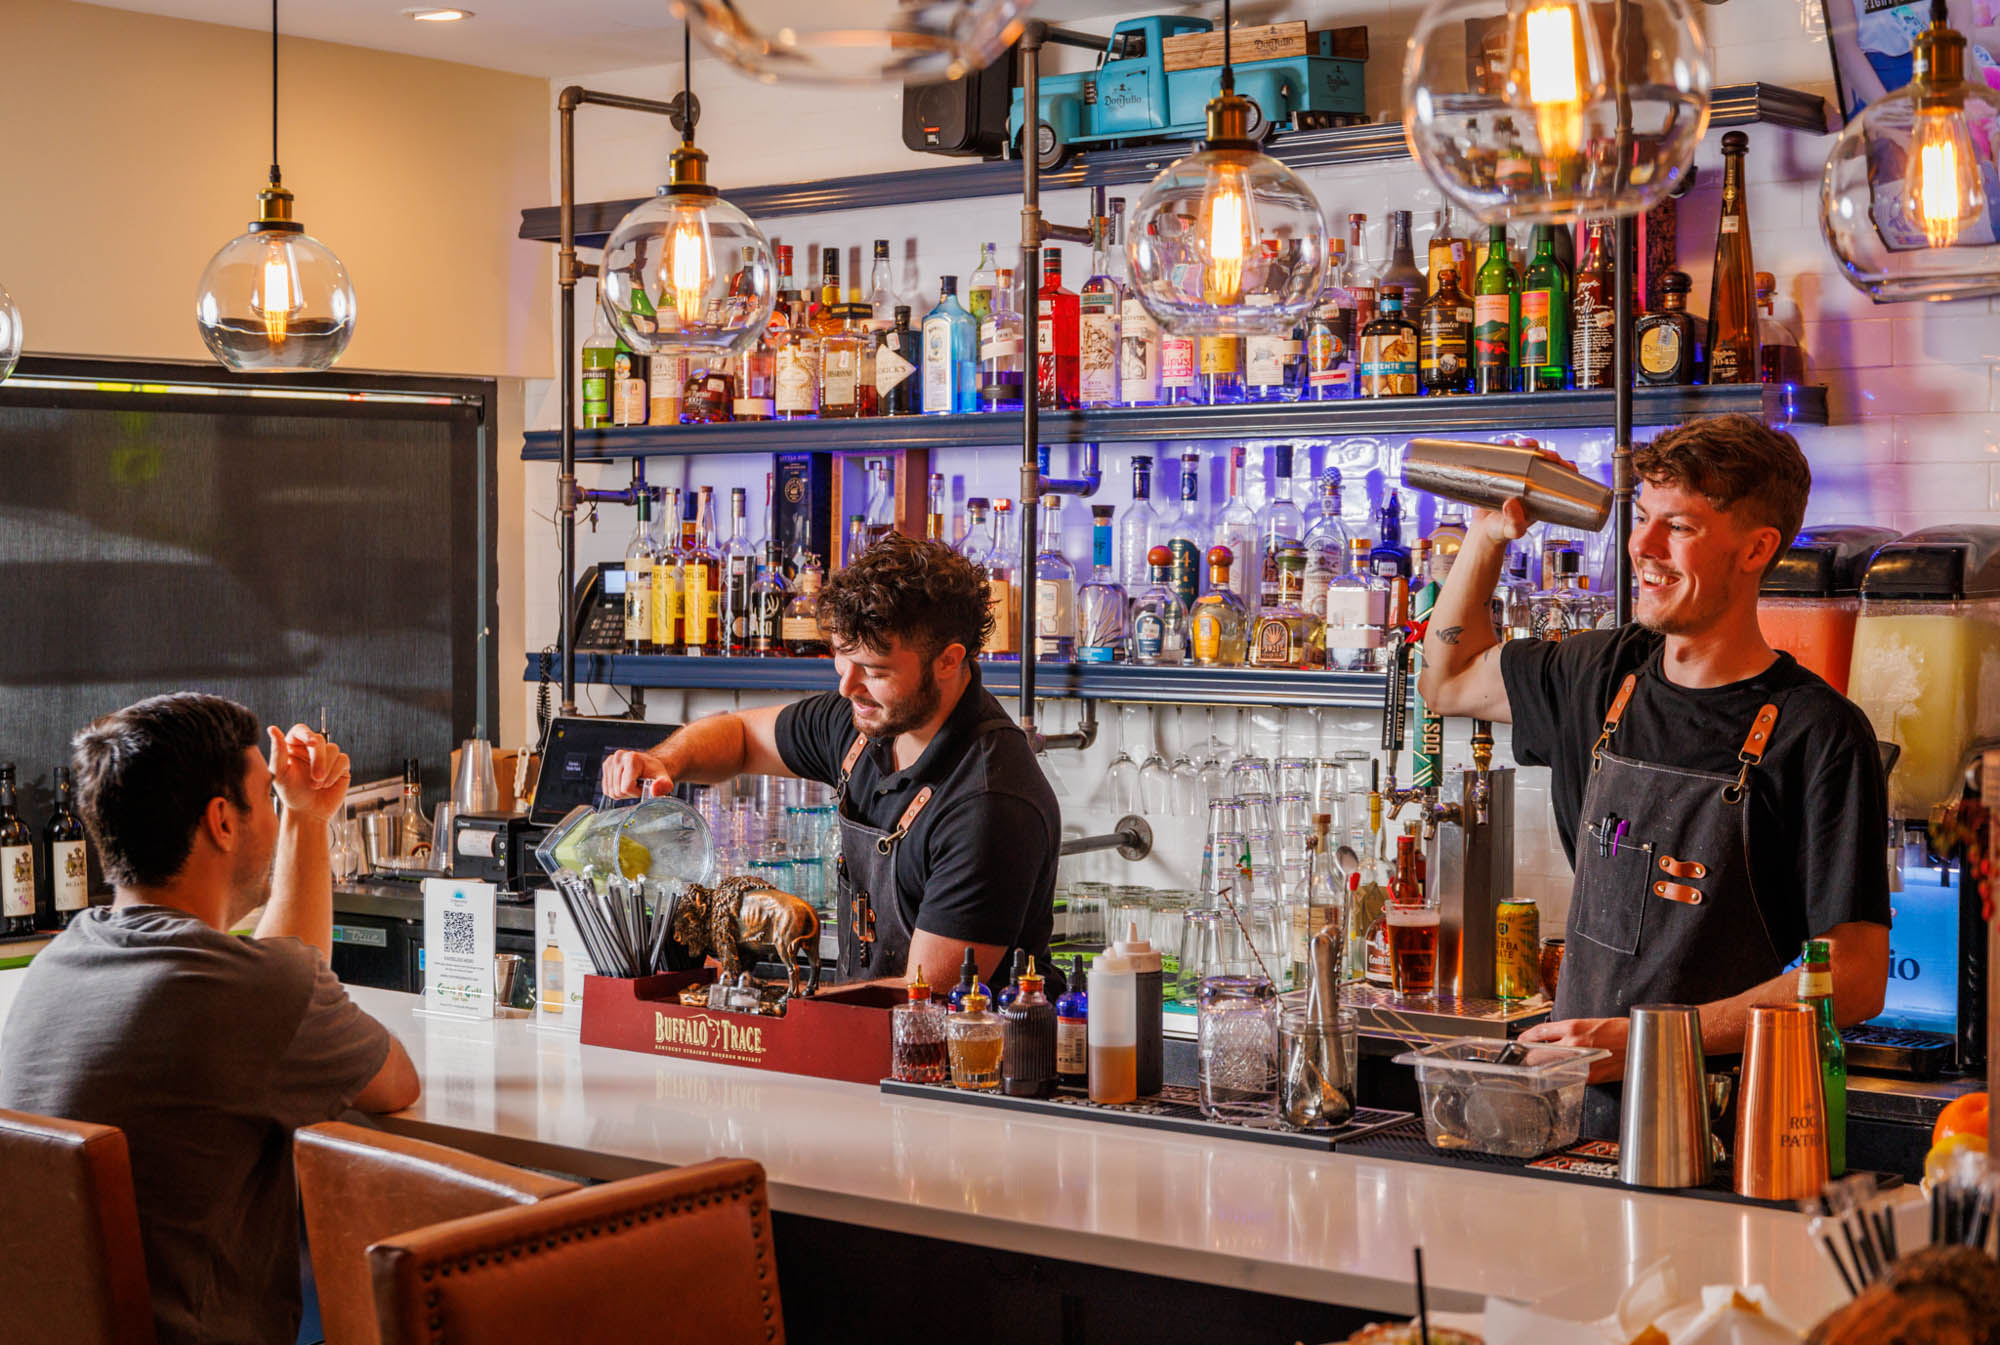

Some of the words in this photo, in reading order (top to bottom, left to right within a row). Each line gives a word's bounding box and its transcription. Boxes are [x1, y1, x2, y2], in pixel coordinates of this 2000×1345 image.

[1104, 95, 1122, 106] Don
[1118, 94, 1143, 108] Julio
[1423, 723, 1440, 754] DOS
[1888, 949, 1921, 980] io
[655, 1011, 709, 1047] BUFFALO
[721, 1019, 762, 1054] TRACE
[682, 1048, 709, 1056] STRAIGHT
[711, 1052, 736, 1060] BOURBON
